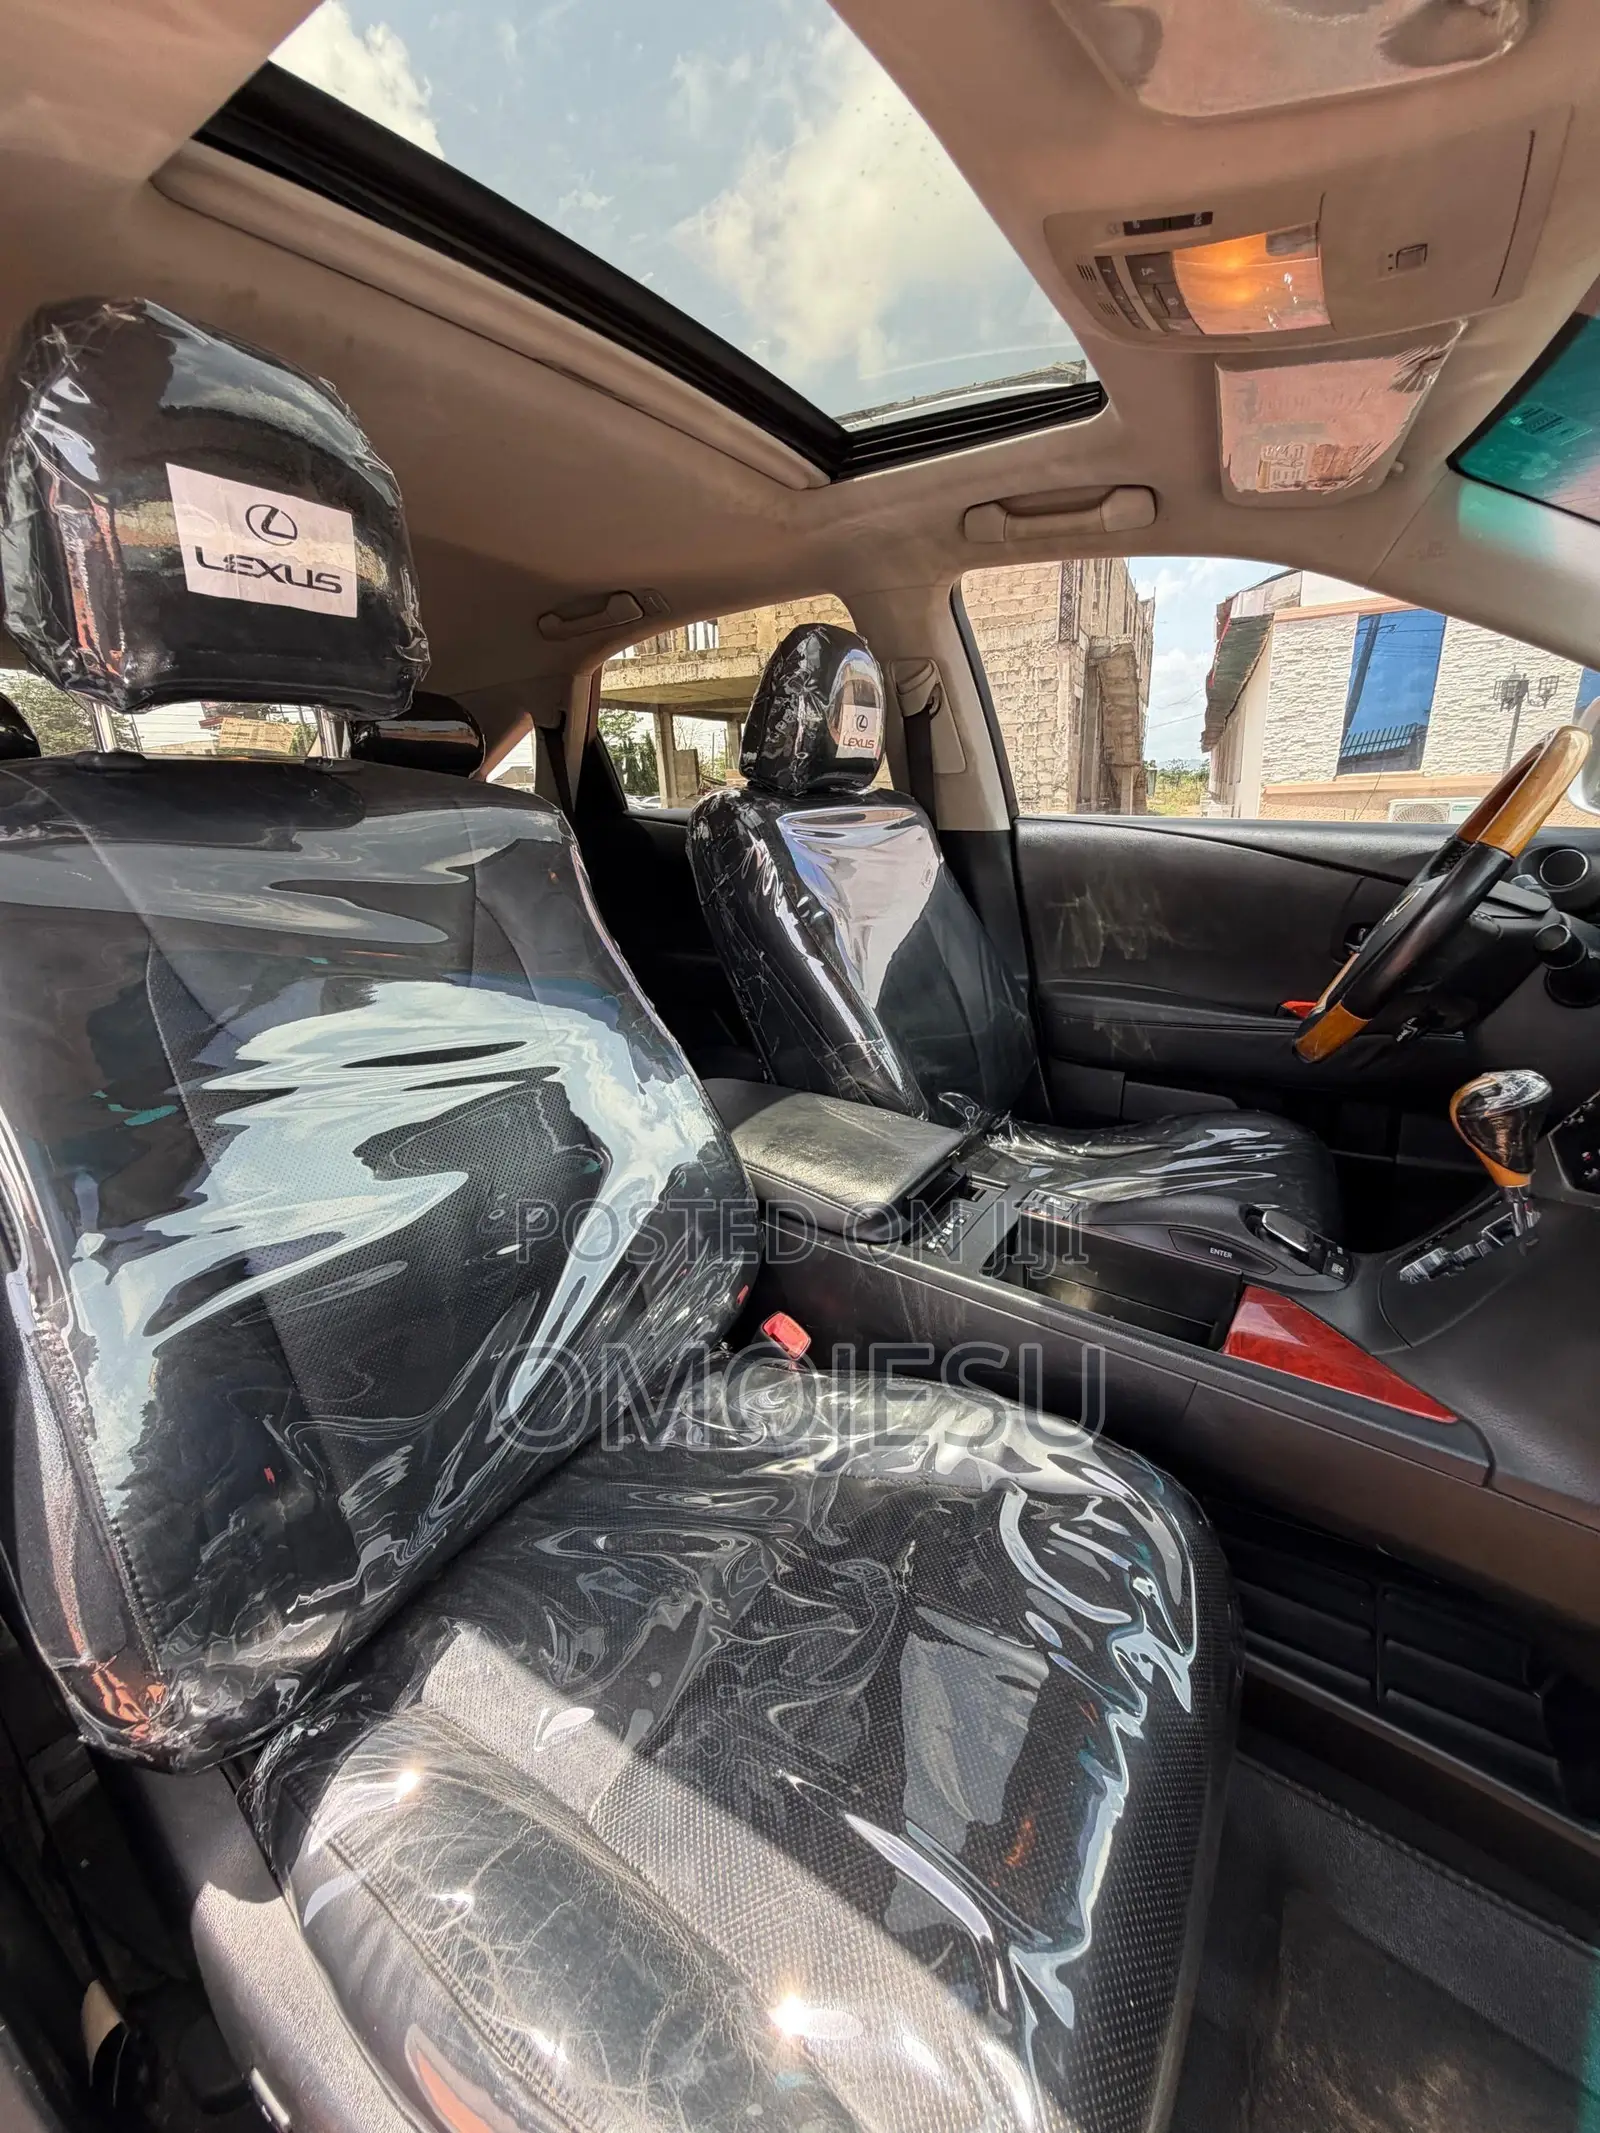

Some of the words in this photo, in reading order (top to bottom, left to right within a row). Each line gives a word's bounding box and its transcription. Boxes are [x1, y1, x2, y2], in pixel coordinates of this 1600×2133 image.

[194, 546, 343, 594] LEXUS
[843, 736, 875, 749] LEXUS
[1209, 1247, 1233, 1260] ENTER
